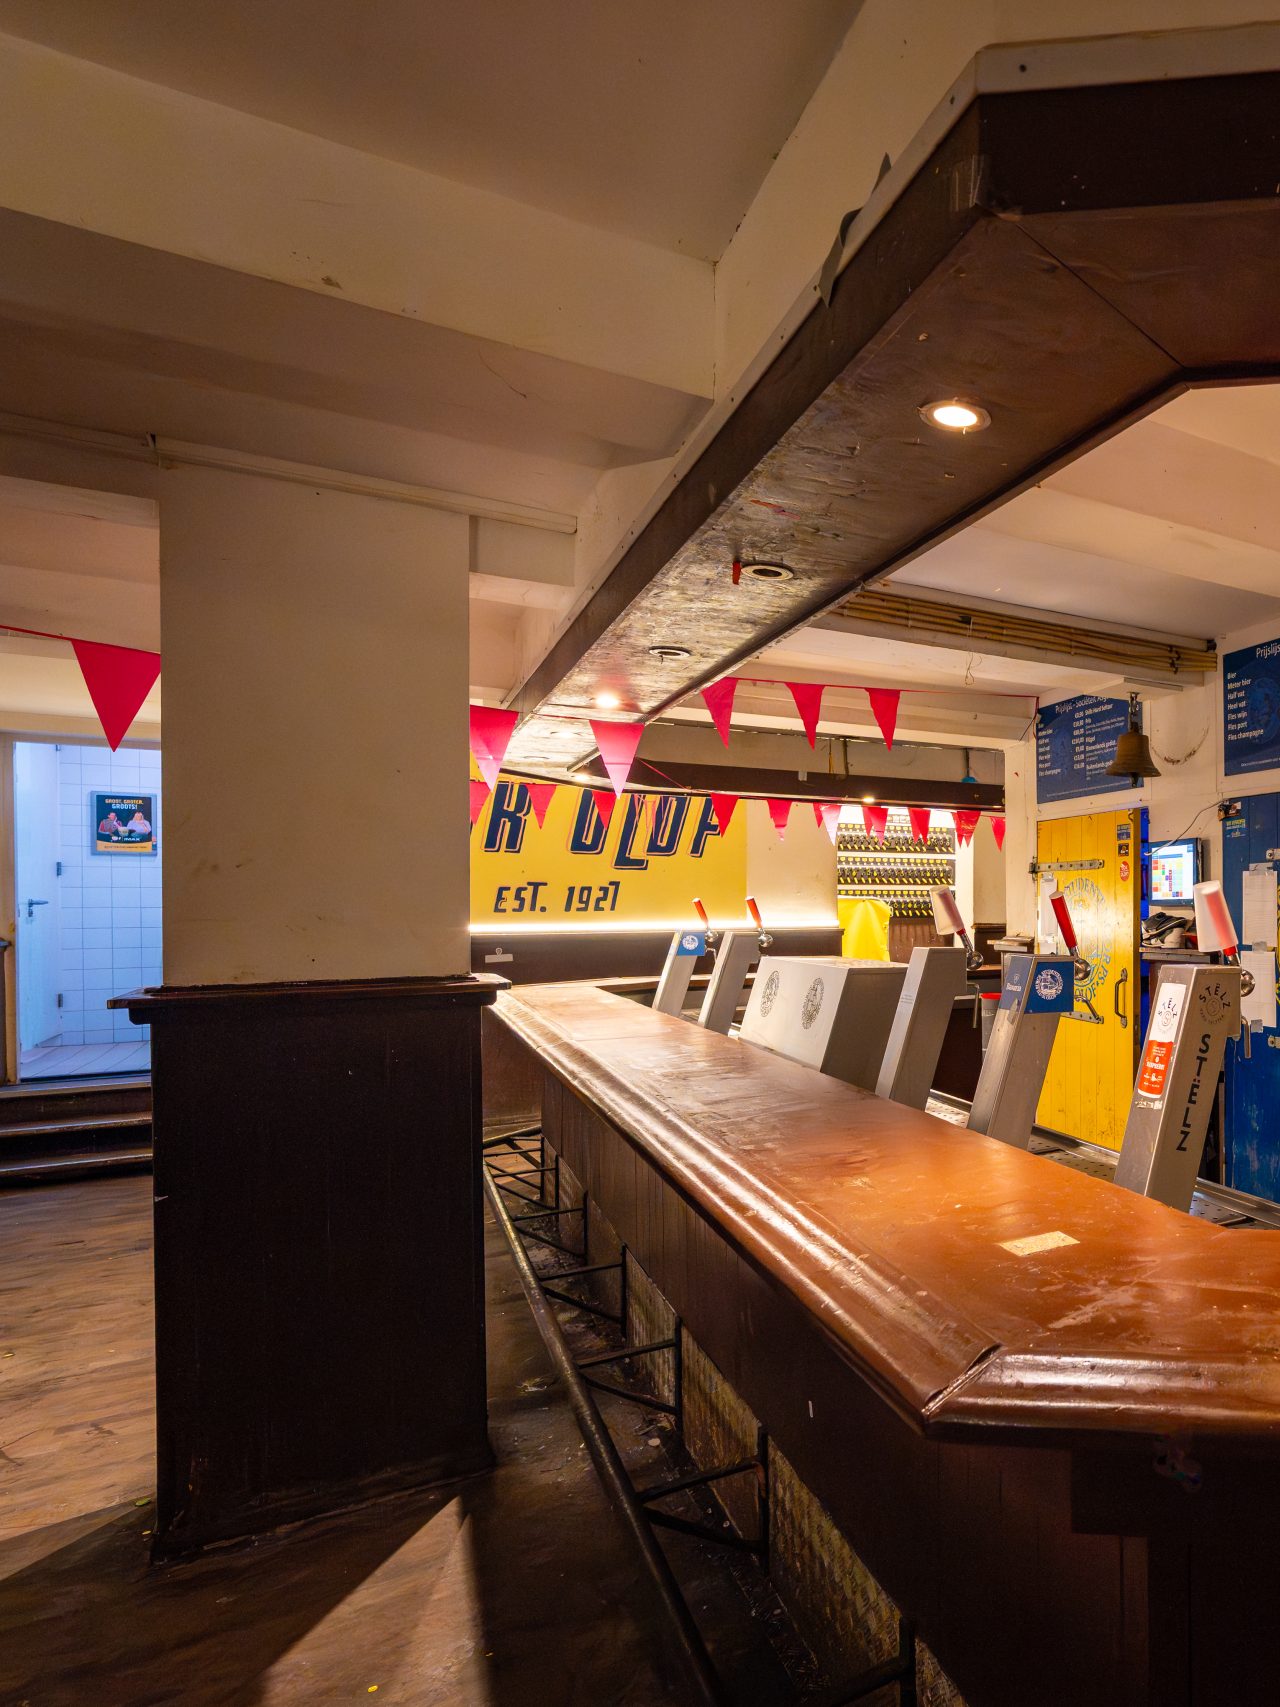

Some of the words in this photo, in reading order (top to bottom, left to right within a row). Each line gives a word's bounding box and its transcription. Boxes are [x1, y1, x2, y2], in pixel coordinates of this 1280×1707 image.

[1241, 678, 1251, 687] bier
[1237, 729, 1264, 739] champagne
[493, 881, 548, 913] EST.
[564, 881, 621, 912] 1927
[1176, 1033, 1211, 1152] STËLZ
